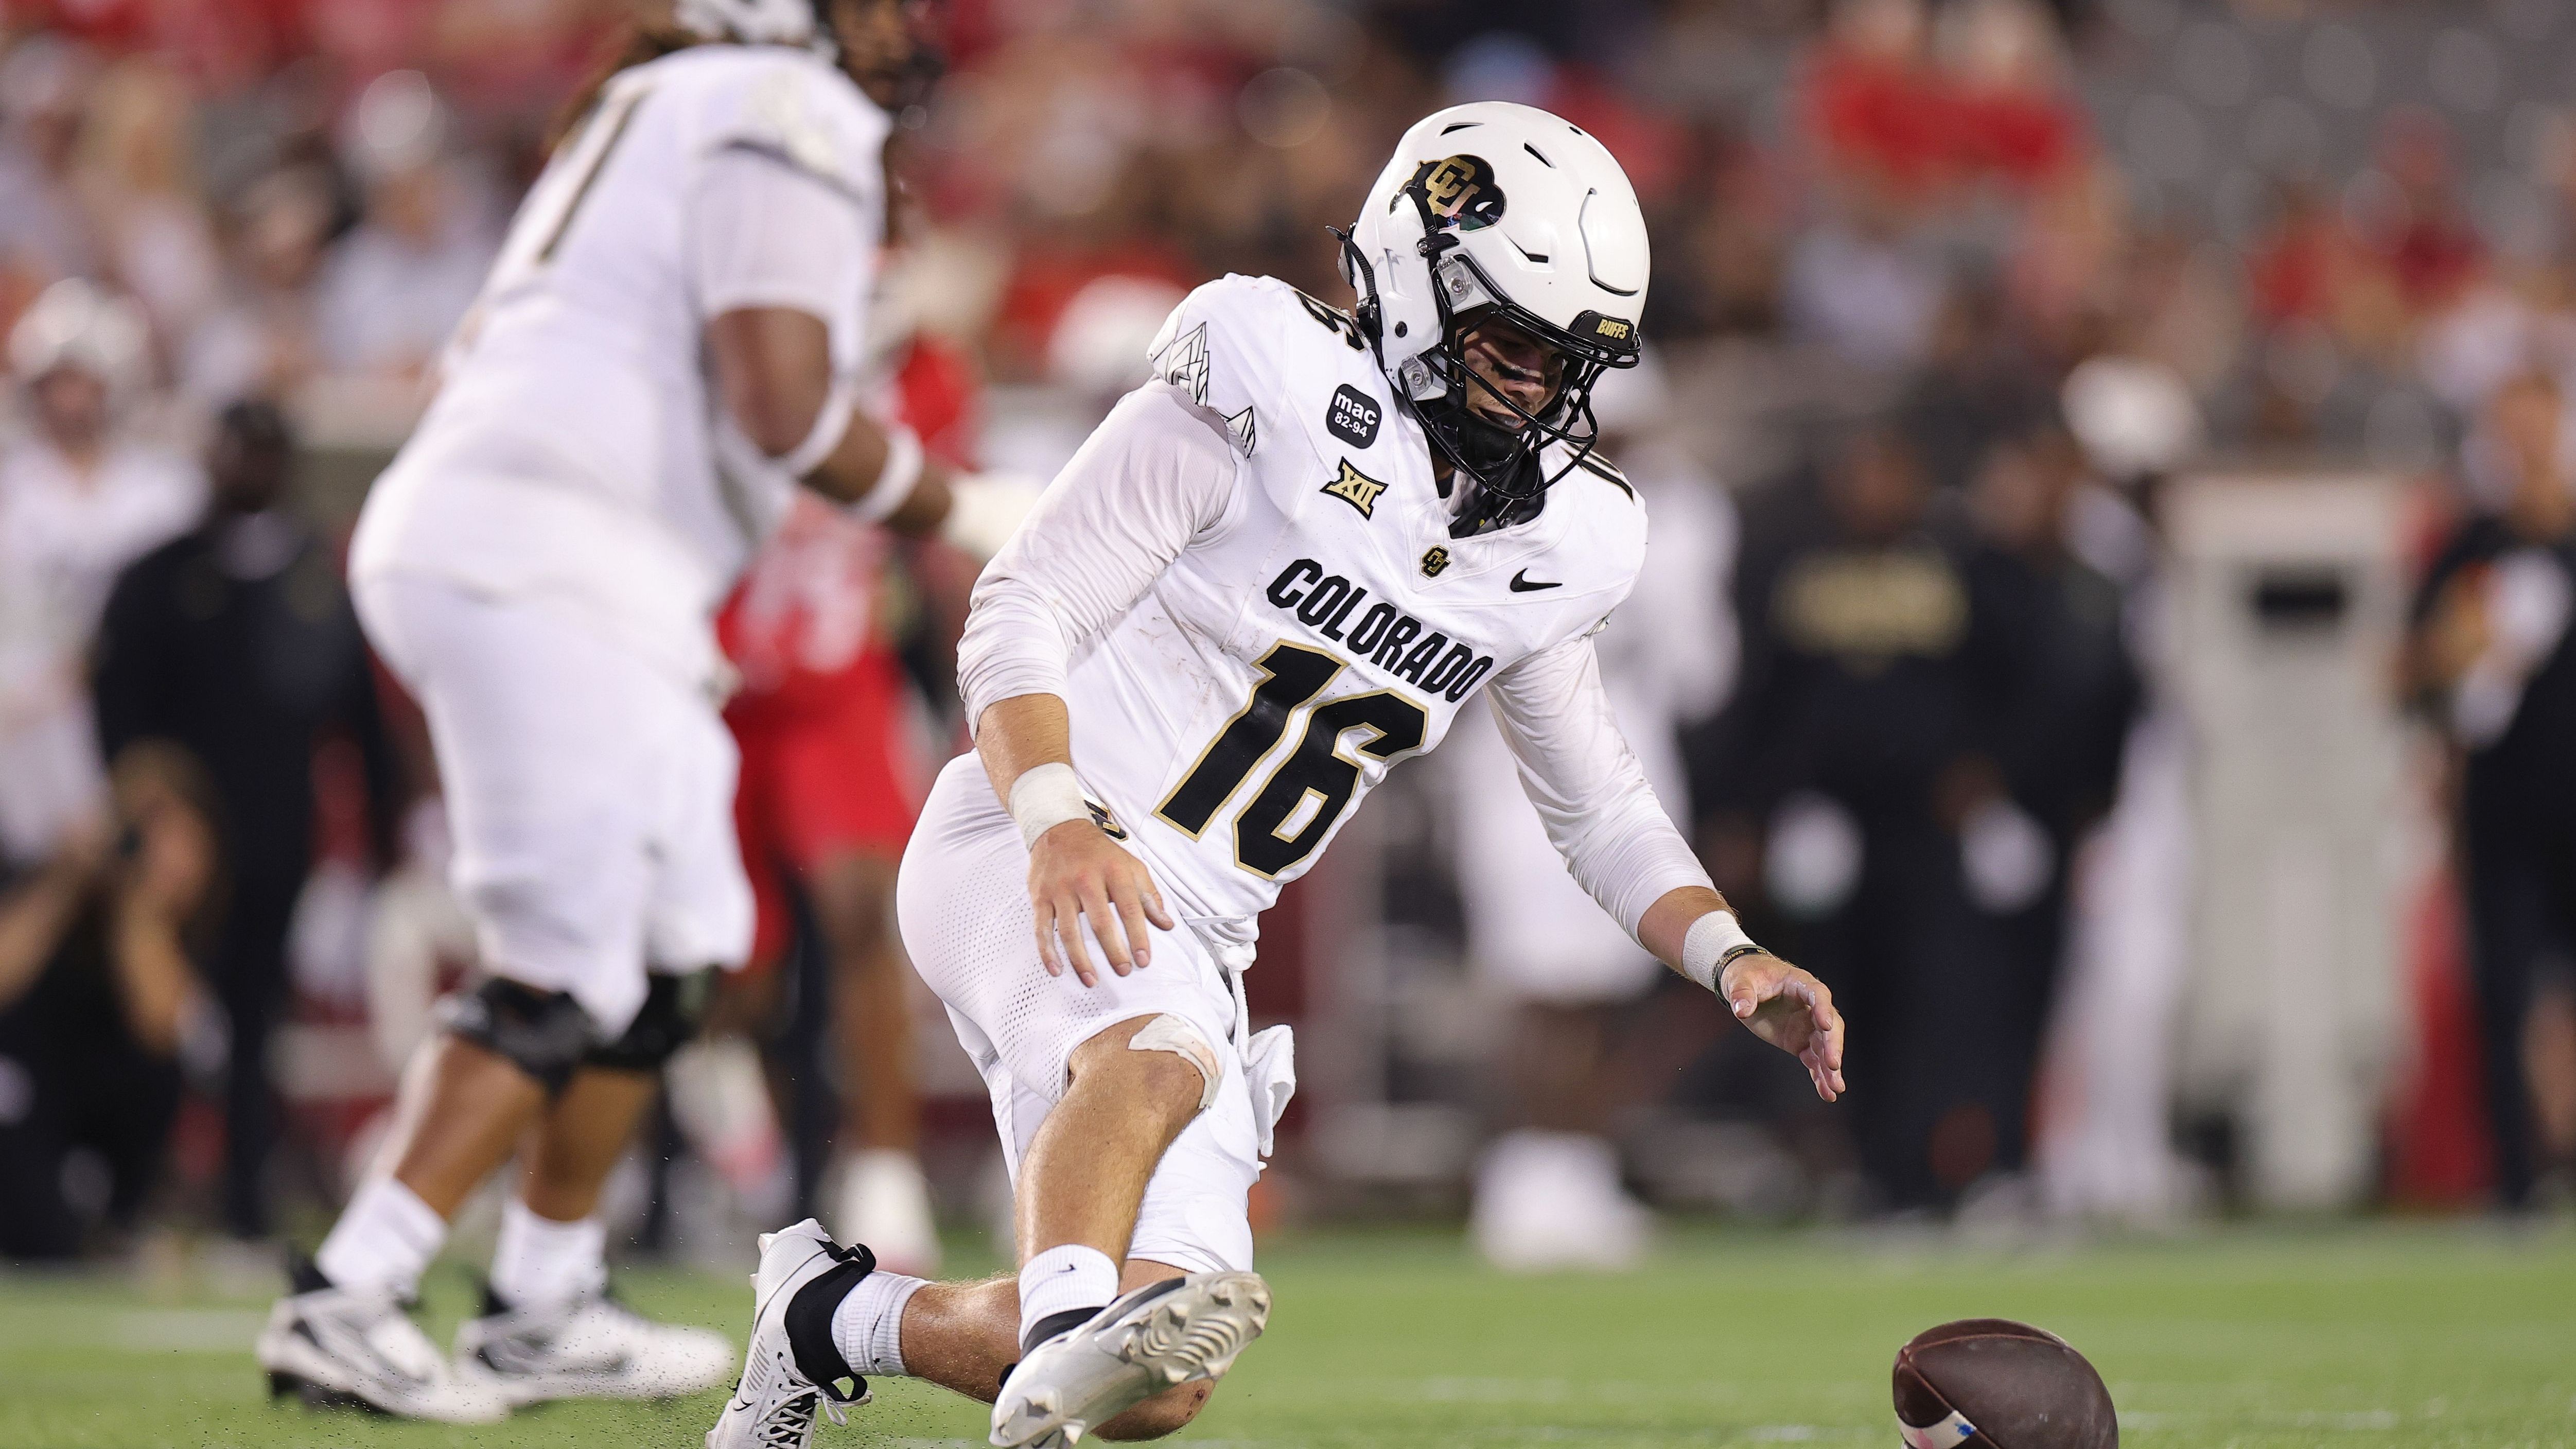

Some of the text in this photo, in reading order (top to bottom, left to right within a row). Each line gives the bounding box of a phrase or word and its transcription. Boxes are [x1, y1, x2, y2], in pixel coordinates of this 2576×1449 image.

[1596, 318, 1629, 340] BUFFS
[1335, 392, 1378, 426] mac
[1335, 411, 1368, 438] 82-94
[1321, 458, 1388, 519] XII
[1267, 558, 1494, 703] COLORADO
[1151, 638, 1429, 881] 16
